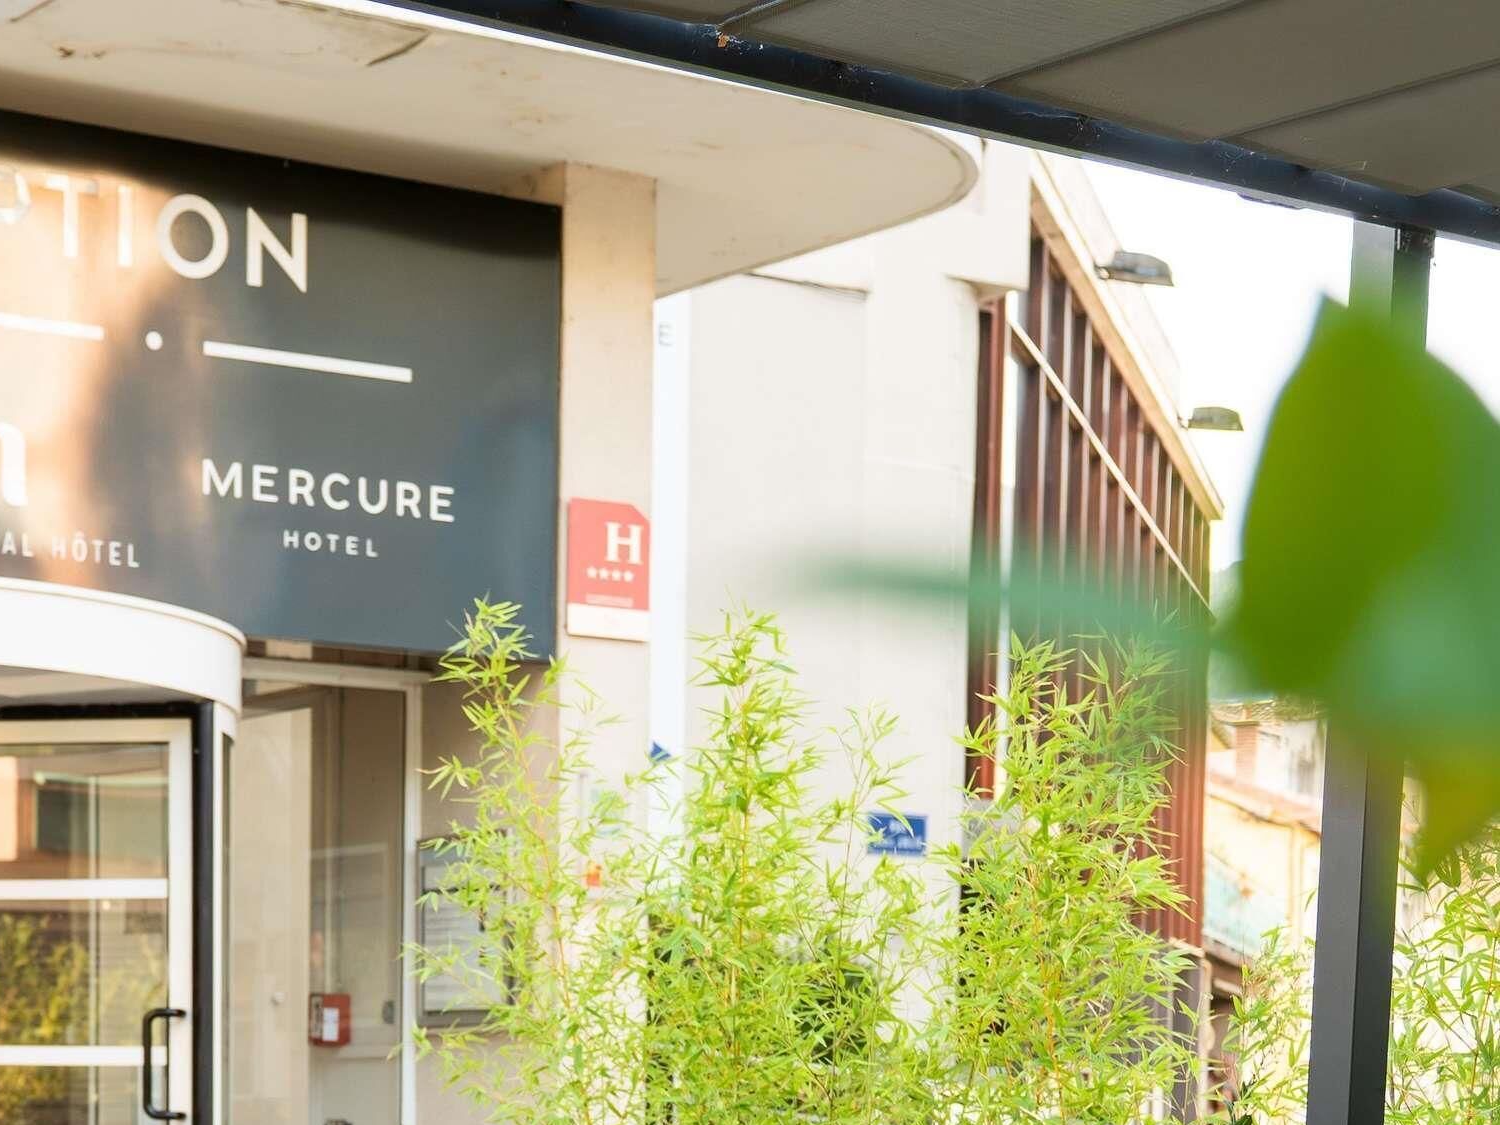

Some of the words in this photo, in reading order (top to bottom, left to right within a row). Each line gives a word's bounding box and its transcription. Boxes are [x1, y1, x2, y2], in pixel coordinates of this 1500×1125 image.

[201, 458, 455, 522] MERCURE
[49, 530, 140, 568] HÔTEL
[283, 529, 378, 558] HOTEL
[605, 520, 643, 566] H
